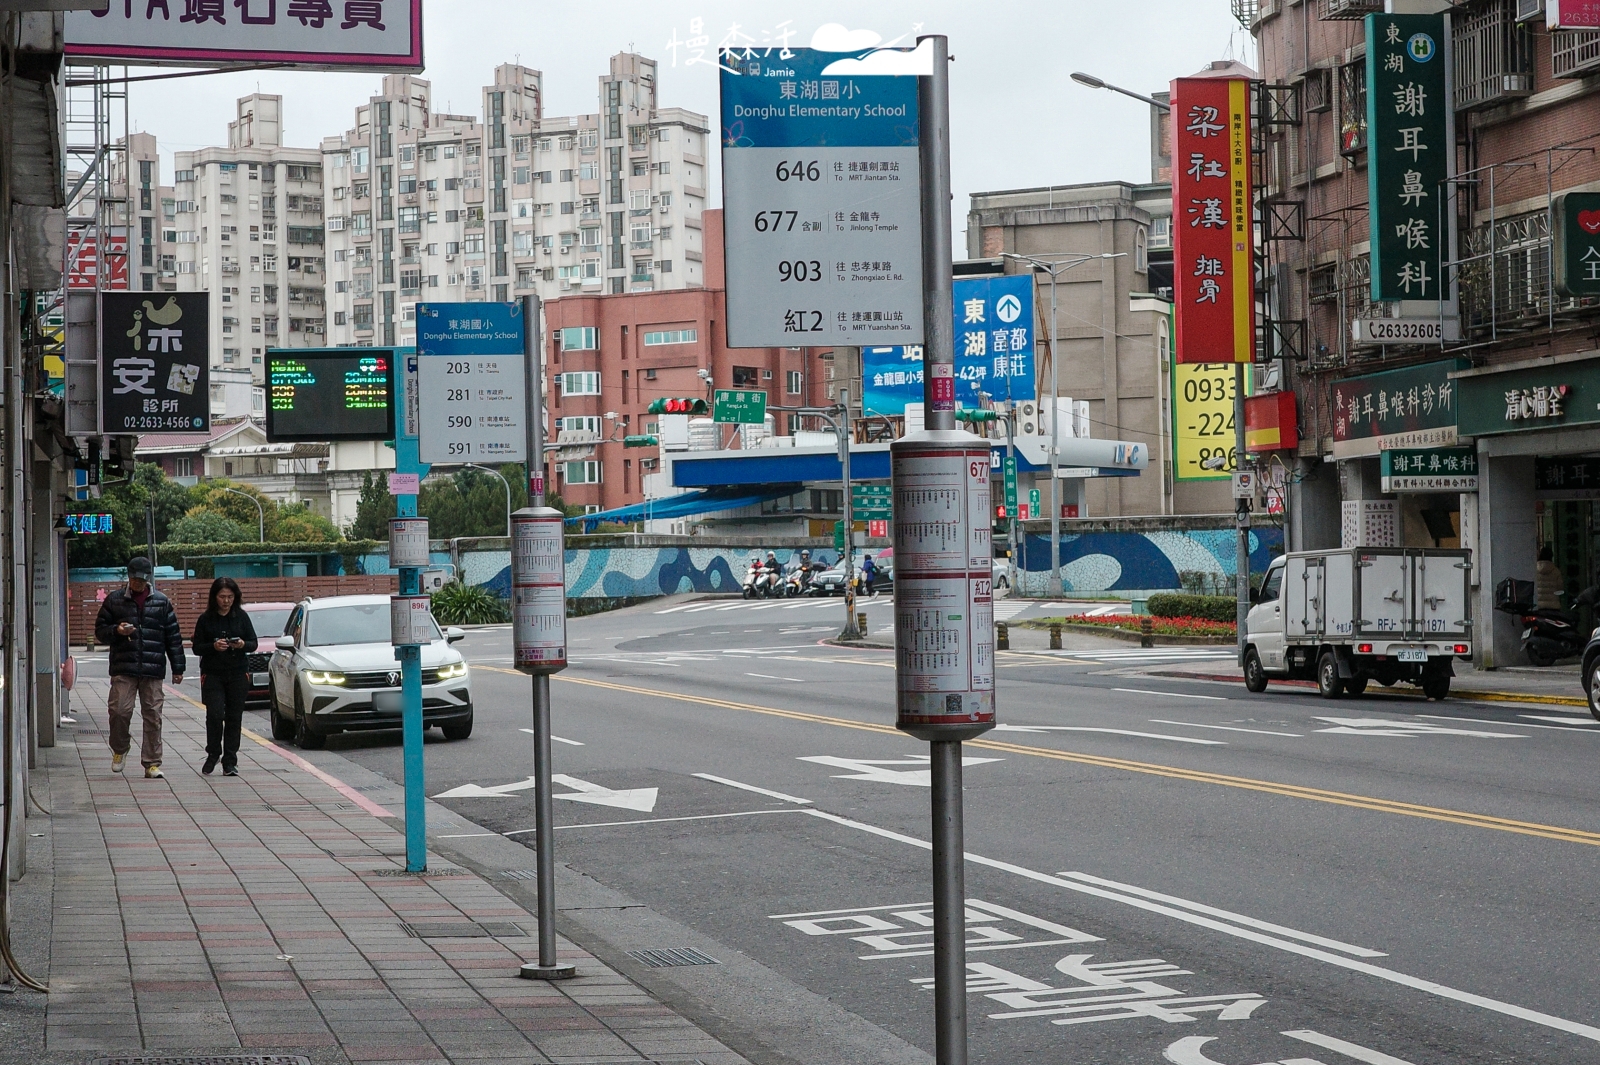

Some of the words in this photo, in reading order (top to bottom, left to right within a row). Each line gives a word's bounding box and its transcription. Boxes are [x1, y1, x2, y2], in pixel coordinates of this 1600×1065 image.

[1384, 23, 1404, 74] 東湖
[779, 80, 861, 100] 東湖國小
[734, 104, 785, 119] Donghu
[789, 104, 861, 119] Elementary
[864, 103, 906, 117] School
[776, 160, 820, 182] 646
[834, 161, 844, 172] 往
[848, 161, 899, 172] 捷運劍潭站
[1186, 105, 1228, 229] 梁社漢
[1393, 84, 1432, 297] 謝耳鼻喉科
[754, 210, 799, 232] 677
[802, 221, 822, 232] 含副
[835, 212, 845, 222] 往
[849, 211, 880, 222] 金龍寺
[850, 224, 873, 232] Jinlong
[874, 224, 899, 232] Temple
[778, 260, 822, 282] 903
[836, 261, 846, 272] 往
[850, 261, 892, 272] 忠孝東路
[851, 274, 886, 282] Zhongxiao
[1194, 254, 1225, 304] 排骨
[784, 309, 823, 332] 紅2
[837, 311, 847, 322] 往
[852, 311, 903, 322] 捷運圓山站
[448, 319, 493, 331] 東湖國小
[963, 298, 986, 357] 東湖
[1377, 323, 1442, 339] 26332605
[424, 332, 452, 341] Donghu
[453, 332, 493, 341] Elementary
[494, 331, 518, 339] School
[446, 362, 470, 374] 203
[447, 389, 470, 401] 281
[1347, 381, 1453, 424] 謝耳鼻喉科診所
[1505, 385, 1562, 420] 清心福全
[143, 398, 179, 412] 診所
[1336, 389, 1346, 436] 東湖
[124, 416, 190, 428] 02-2633-4566
[447, 415, 472, 428] 590
[448, 442, 471, 455] 591
[1115, 444, 1139, 465] NPC
[970, 461, 990, 477] 677
[1393, 453, 1476, 472] 謝耳鼻喉科
[1546, 464, 1600, 485] 謝耳
[412, 602, 425, 610] 896
[1426, 619, 1446, 632] 1871
